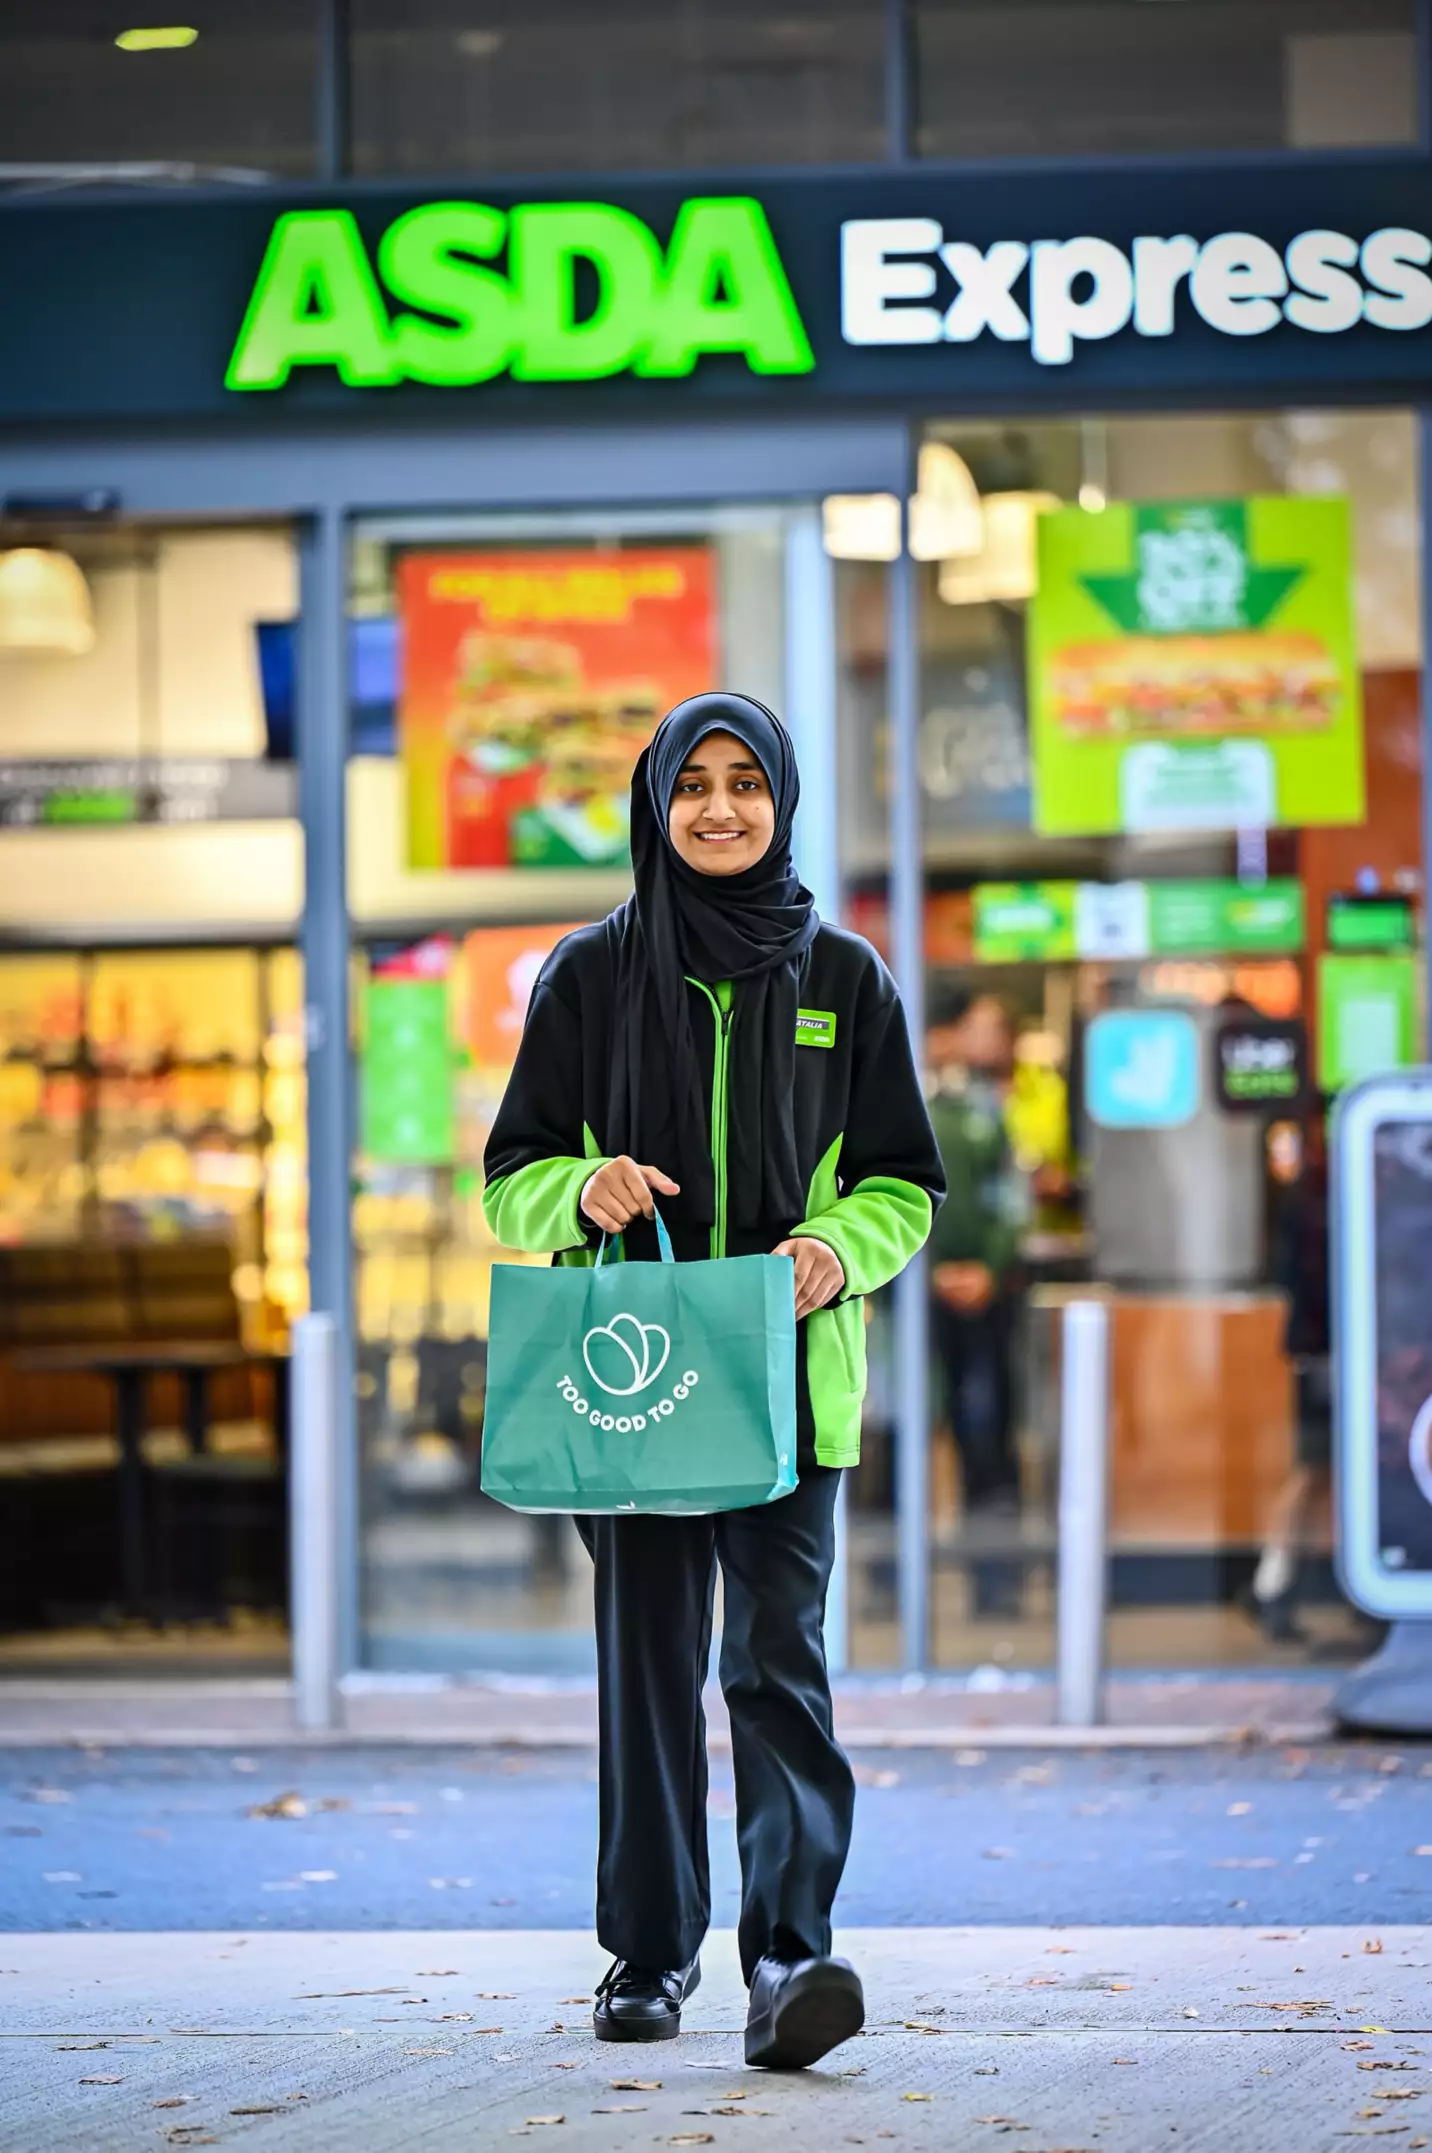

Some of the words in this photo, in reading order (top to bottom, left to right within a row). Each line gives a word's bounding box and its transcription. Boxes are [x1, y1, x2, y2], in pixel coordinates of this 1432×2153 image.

[226, 198, 814, 390] ASDA
[841, 218, 1432, 364] Express
[556, 1374, 589, 1415] TOO
[589, 1409, 647, 1433] GOOD
[647, 1398, 675, 1423] TO
[672, 1369, 699, 1400] GO
